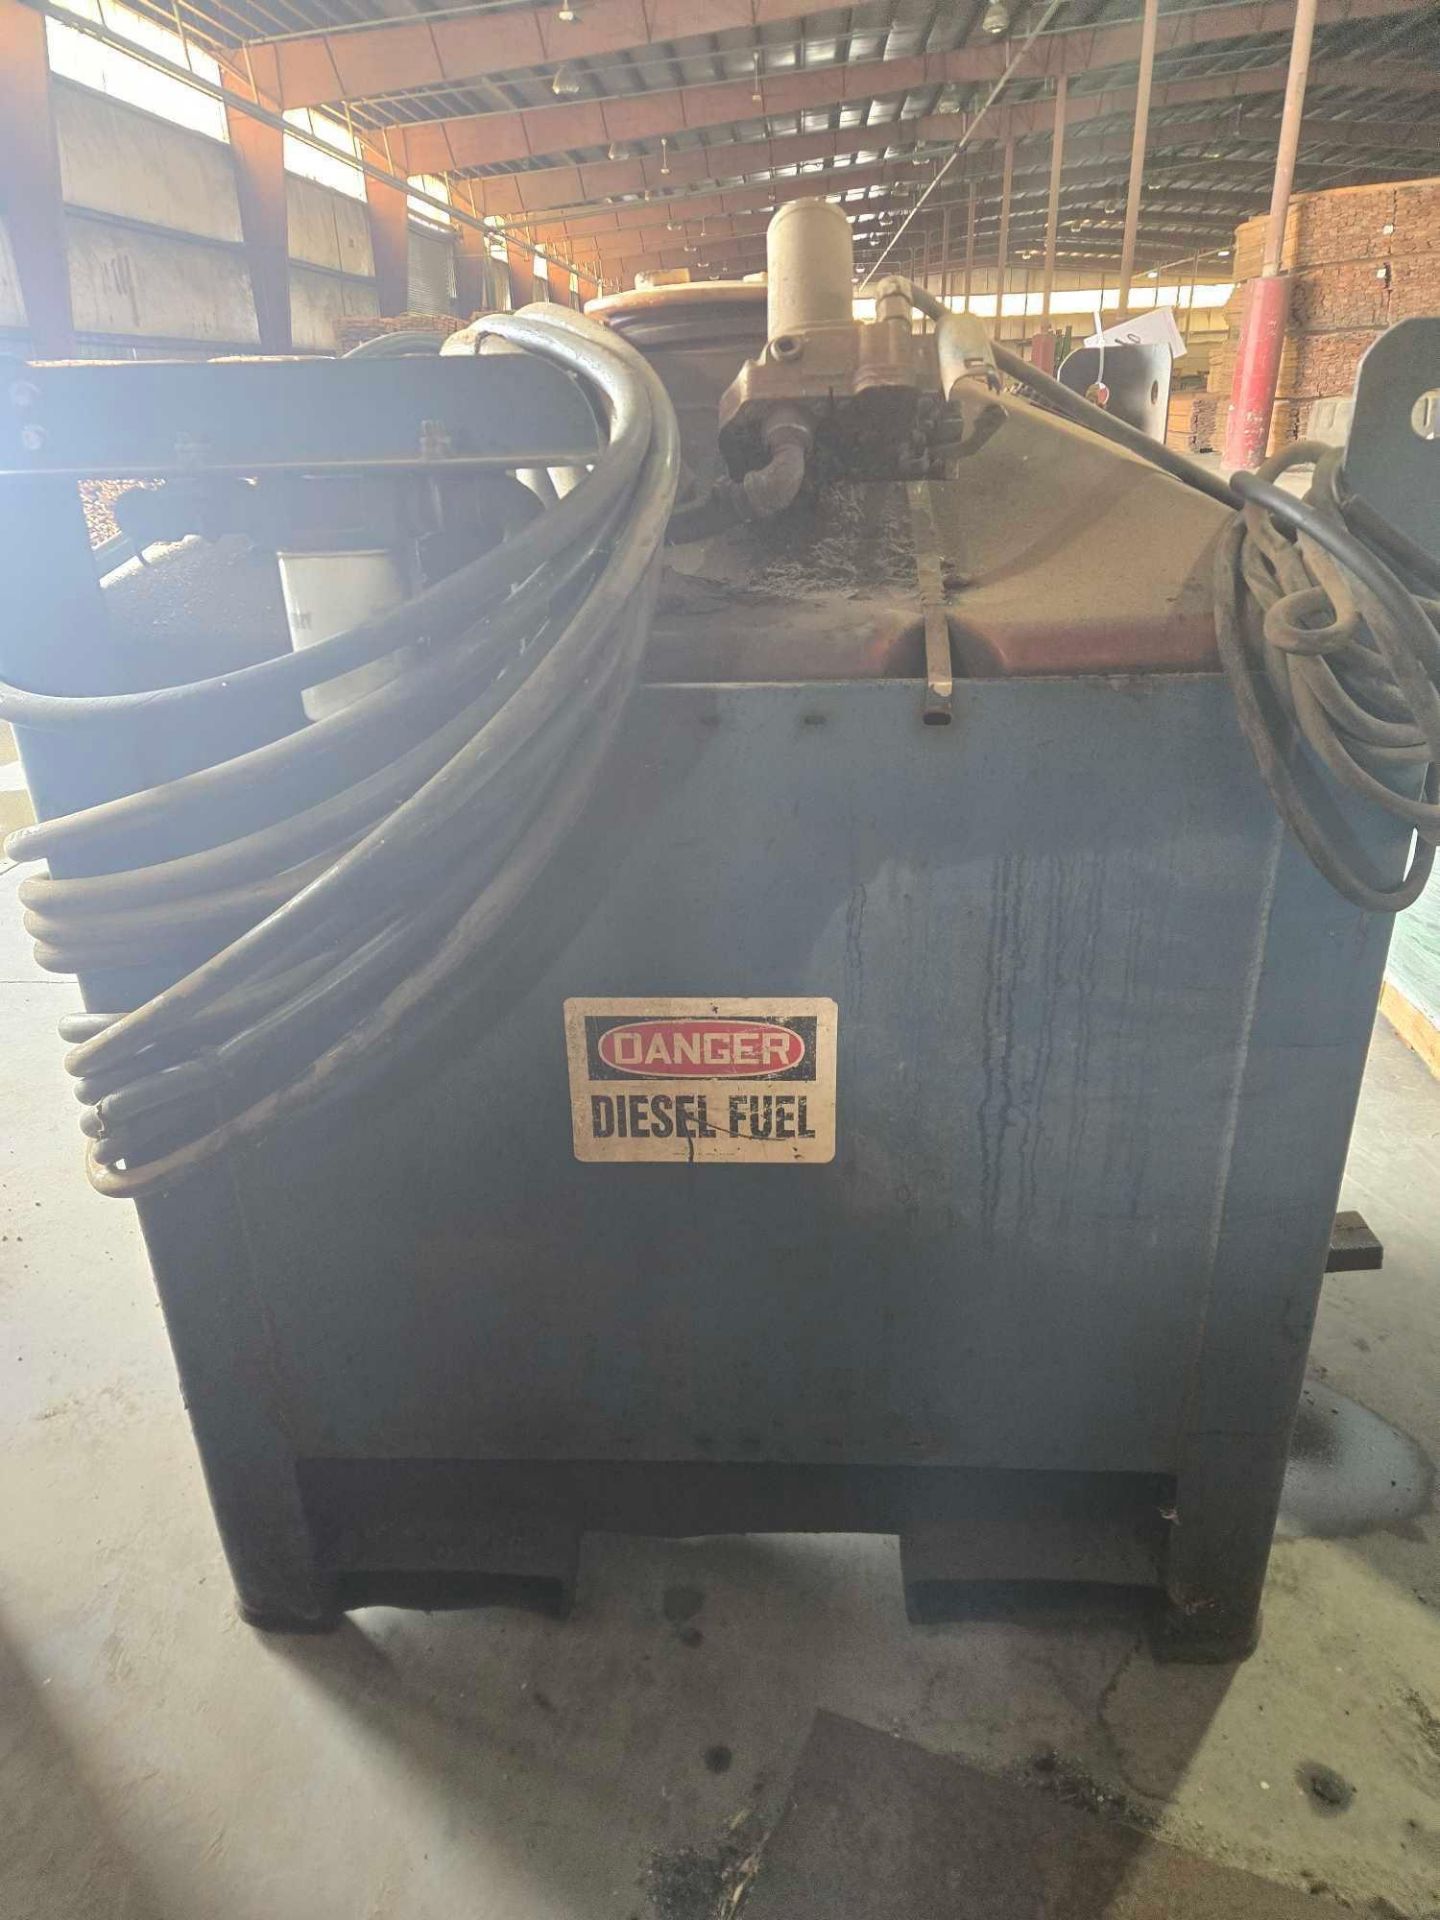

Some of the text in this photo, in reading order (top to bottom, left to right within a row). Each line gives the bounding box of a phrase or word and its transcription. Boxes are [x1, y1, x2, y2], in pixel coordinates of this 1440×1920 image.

[613, 1032, 790, 1065] DANGER
[590, 1094, 816, 1138] DIESEL FUEL
